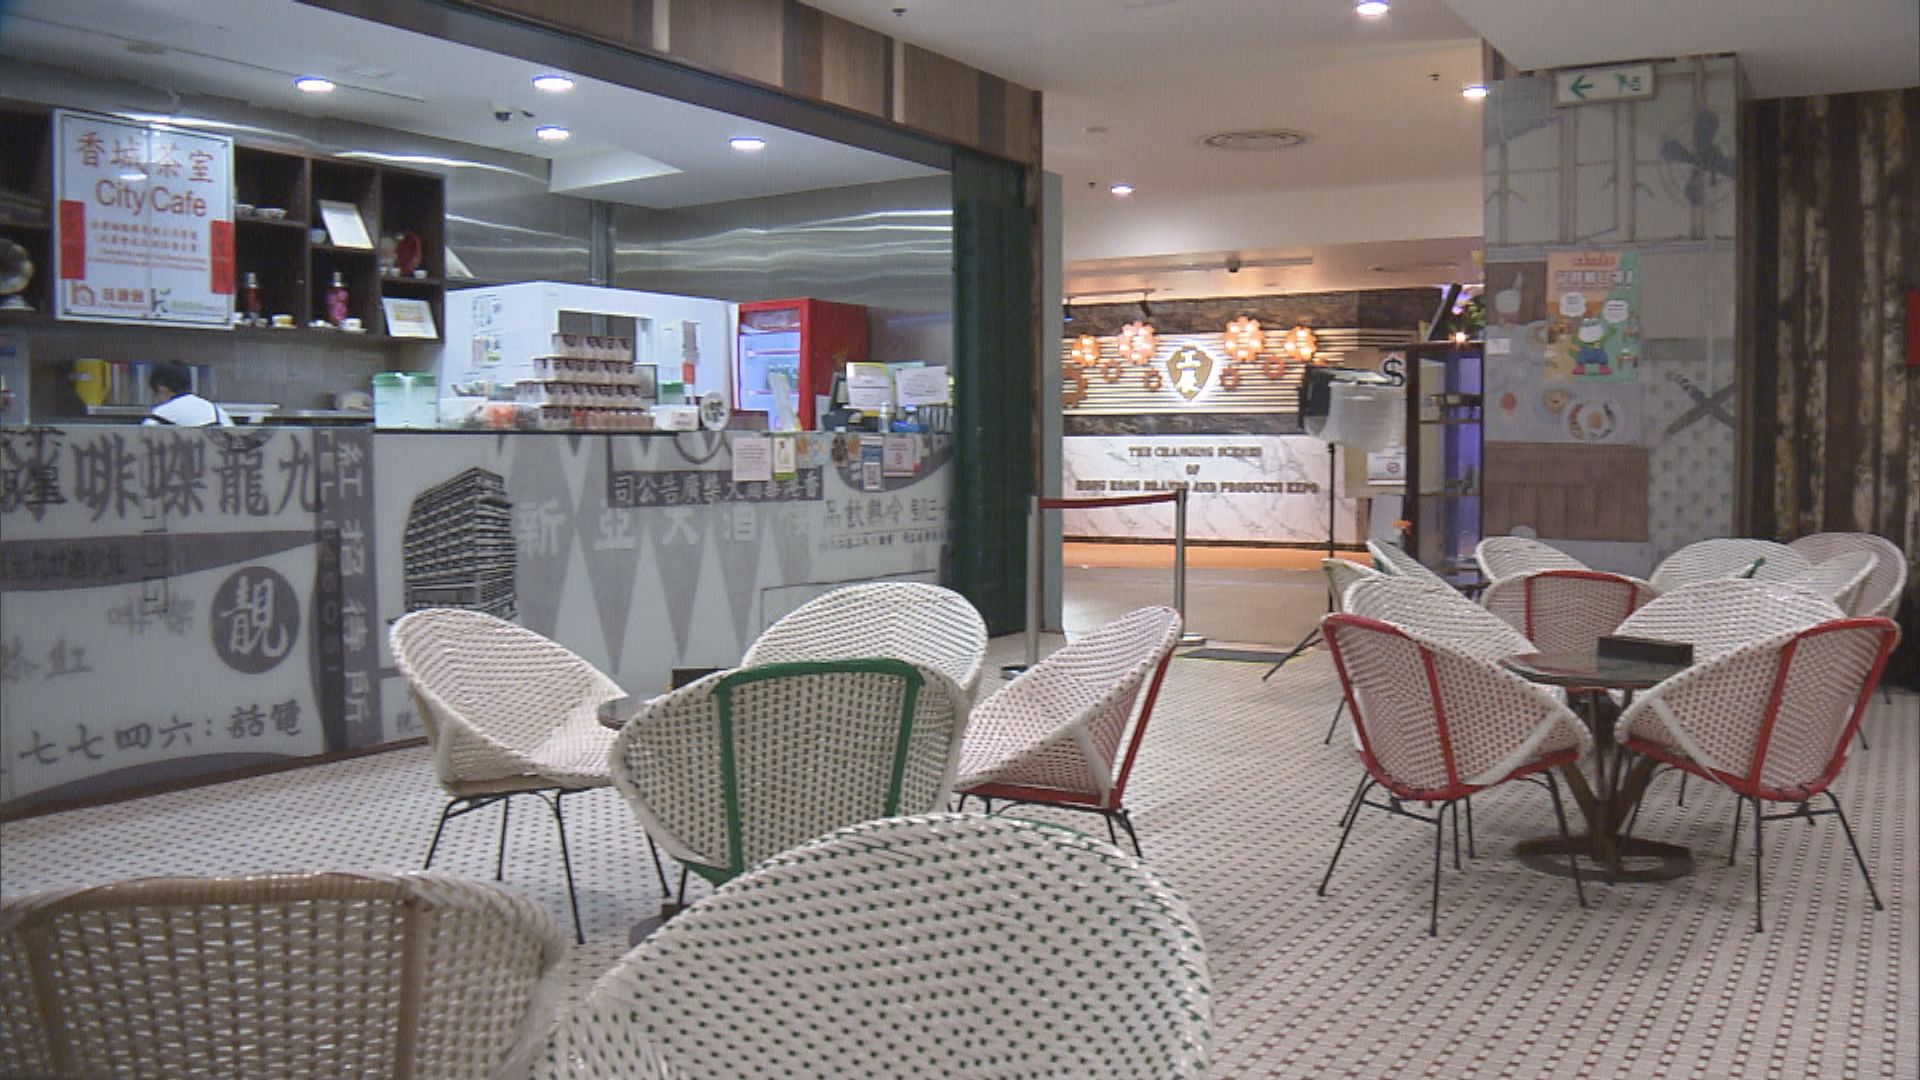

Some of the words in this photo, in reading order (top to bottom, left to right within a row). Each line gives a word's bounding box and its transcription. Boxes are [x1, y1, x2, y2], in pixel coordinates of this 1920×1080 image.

[77, 131, 214, 184] 香城茶室
[95, 179, 146, 216] City
[151, 185, 207, 217] Cafe
[221, 572, 290, 658] 靚
